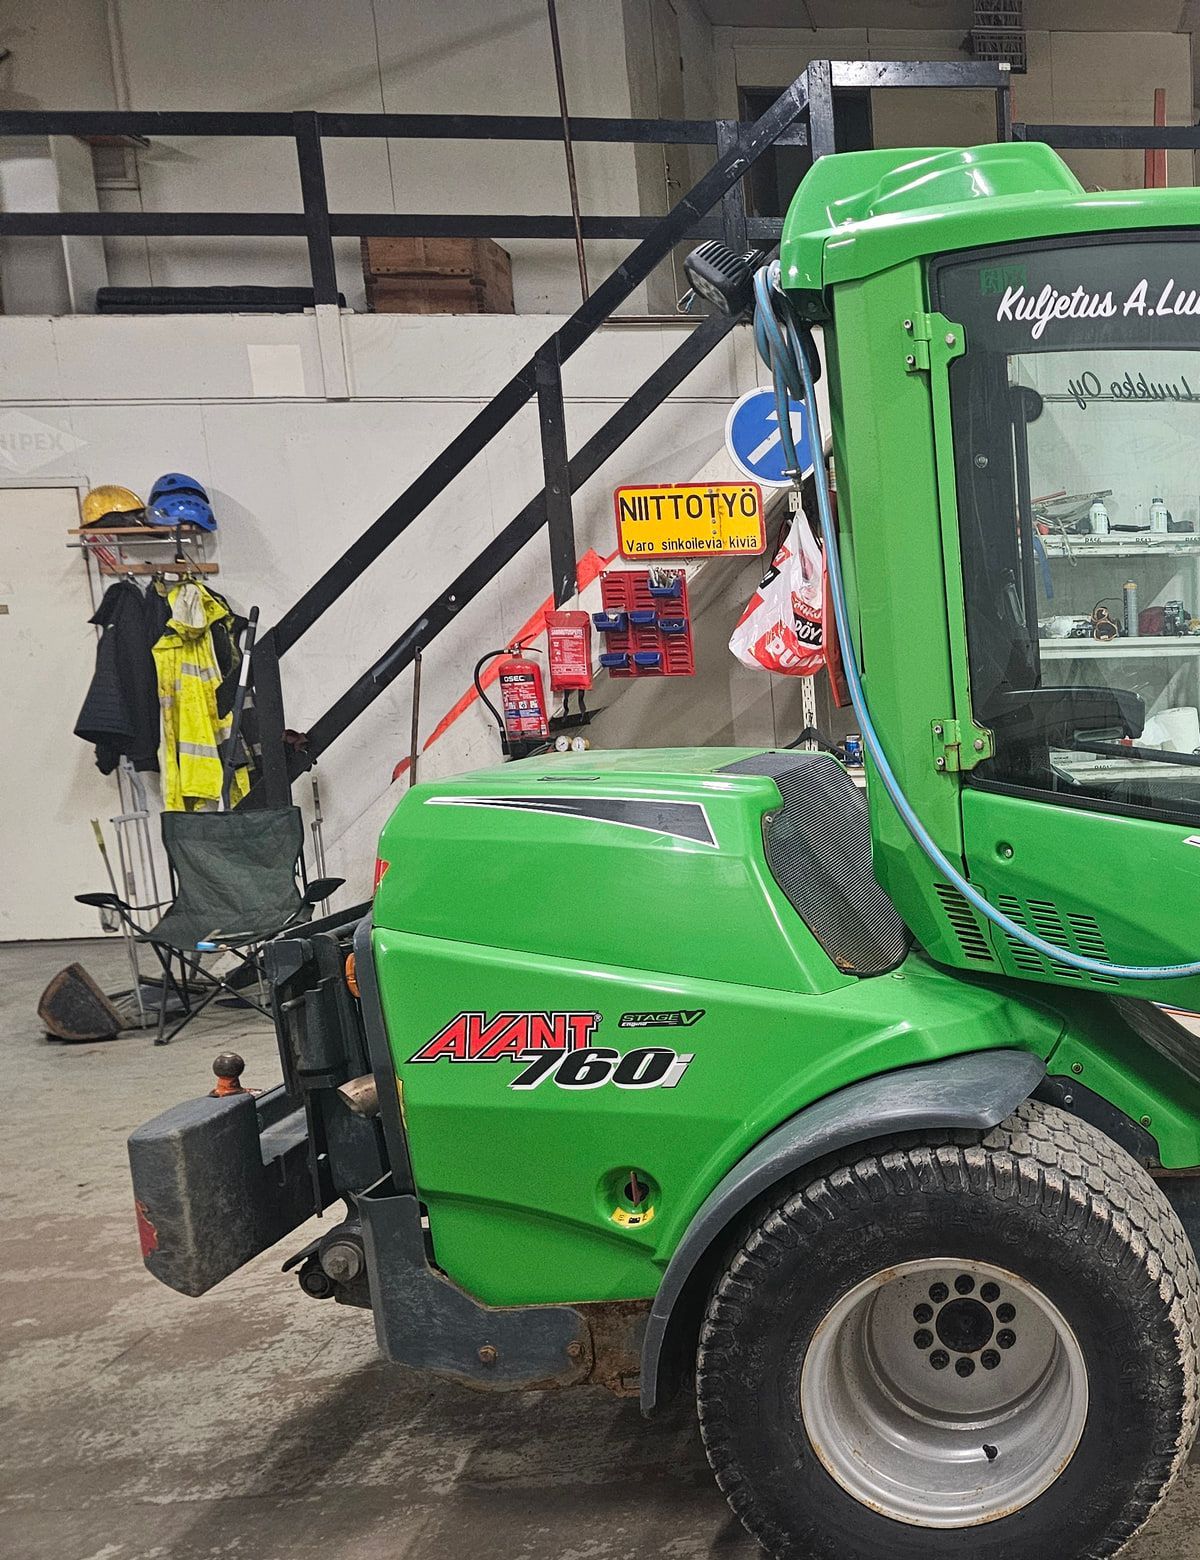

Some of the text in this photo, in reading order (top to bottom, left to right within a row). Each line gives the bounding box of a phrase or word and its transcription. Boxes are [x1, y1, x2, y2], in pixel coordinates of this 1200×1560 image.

[997, 284, 1117, 339] Kuljetus
[620, 488, 757, 522] NIITTOTYÖ
[626, 535, 757, 552] Varo sinkoilevia kiviä
[405, 1010, 600, 1063] AVANT
[507, 1047, 696, 1090] 760i
